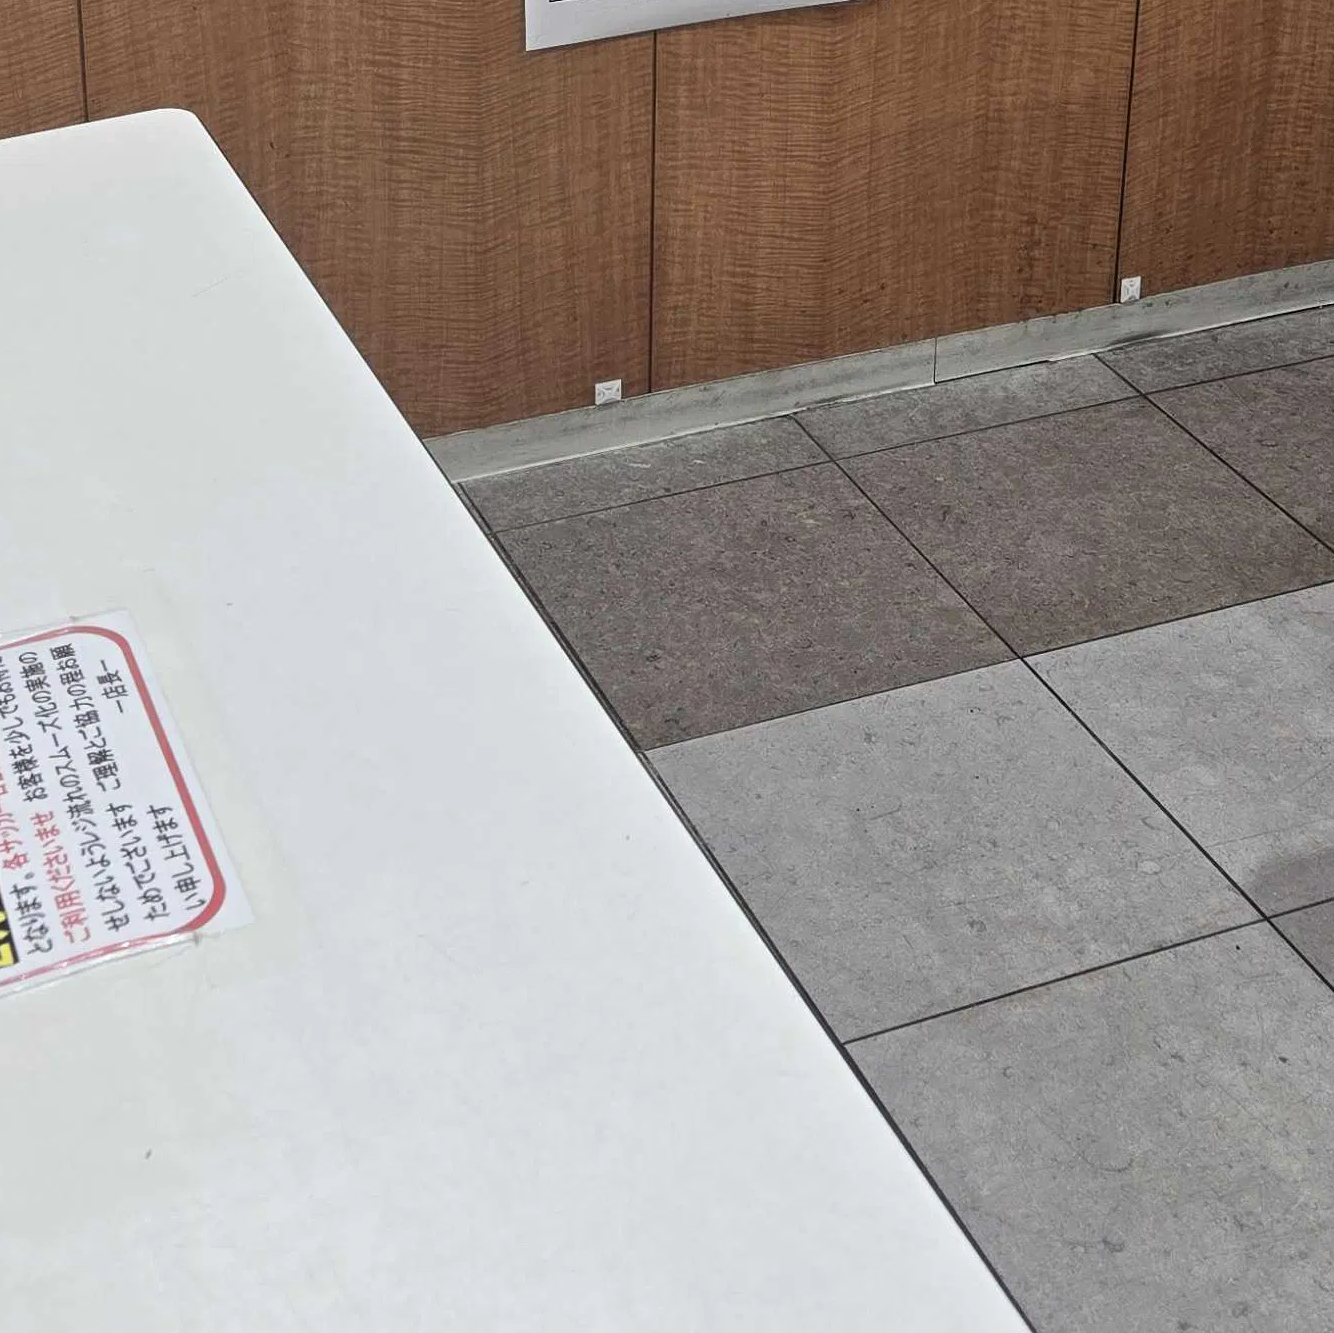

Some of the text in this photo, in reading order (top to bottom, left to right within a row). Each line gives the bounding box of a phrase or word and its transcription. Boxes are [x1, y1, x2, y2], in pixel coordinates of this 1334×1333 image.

[18, 650, 130, 932] せしないようレジ流れのスムーズ化の実施の
[31, 809, 91, 944] ご利用くださいませ
[49, 642, 170, 923] ためでございます ご理解とご協力の程お願
[146, 805, 206, 912] い申し上げます
